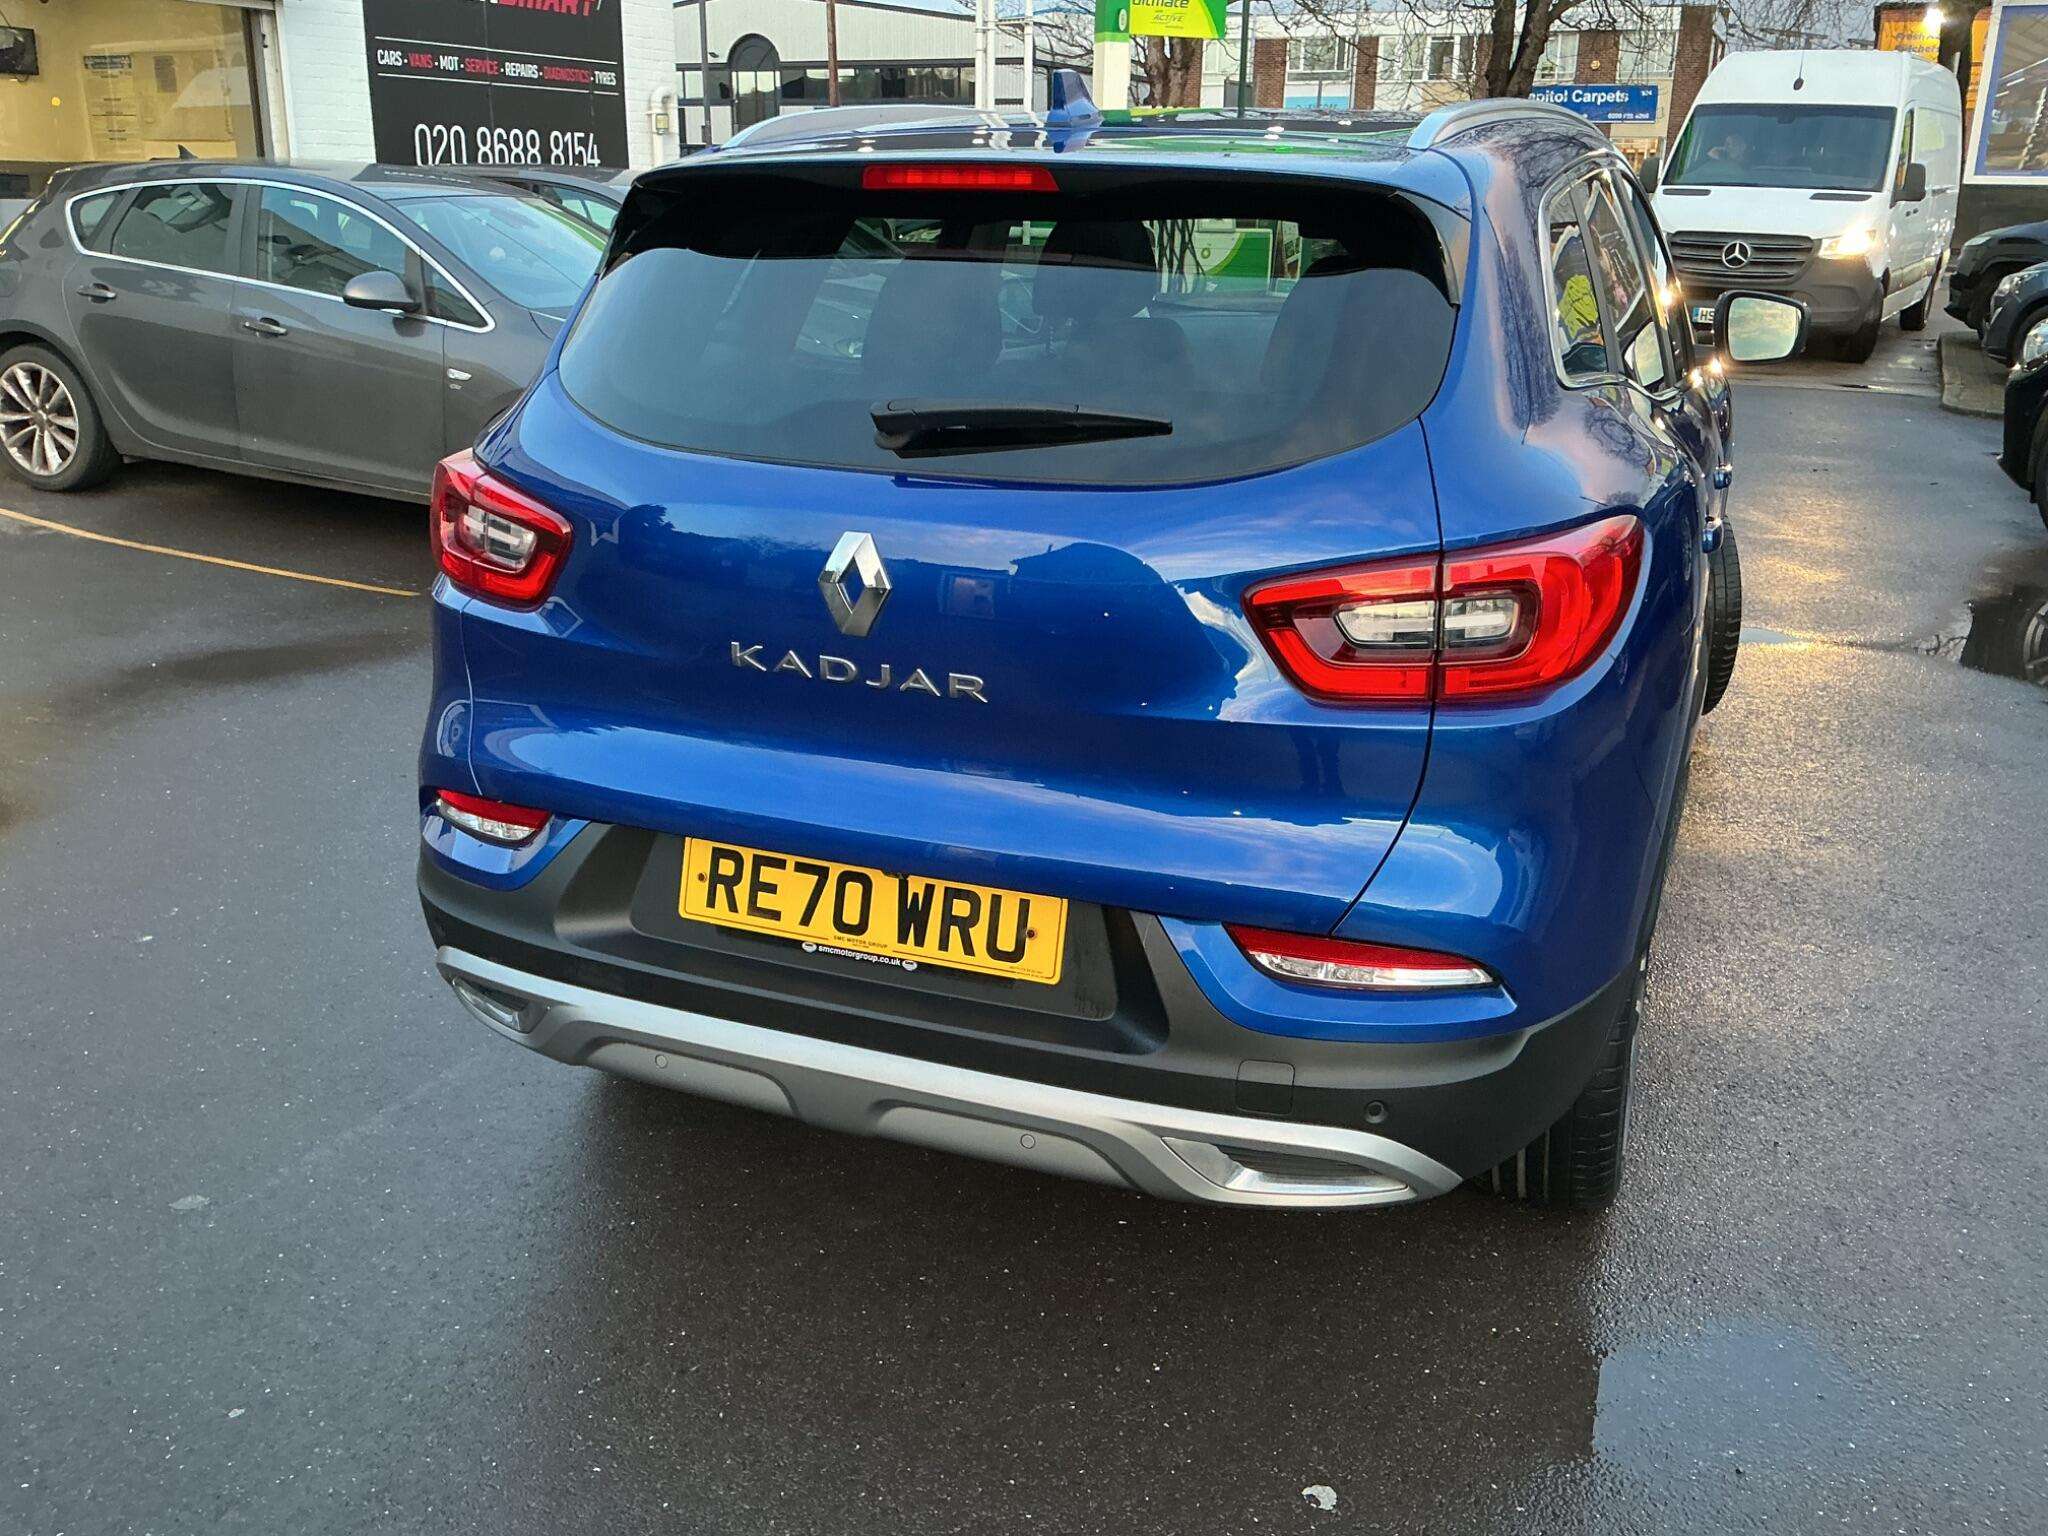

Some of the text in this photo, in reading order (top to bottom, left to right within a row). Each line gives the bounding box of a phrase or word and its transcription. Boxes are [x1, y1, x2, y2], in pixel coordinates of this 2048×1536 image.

[377, 50, 616, 85] CARS VANS MOT SERVICE REPAIRS DIAGNOSTICS TYRES
[1572, 90, 1629, 105] Carpets
[414, 123, 601, 166] 020 8688 8154
[731, 641, 988, 703] KADJAR
[706, 846, 1030, 963] RE70 WRU
[818, 945, 901, 966] smcmotorgroup.co.uk
